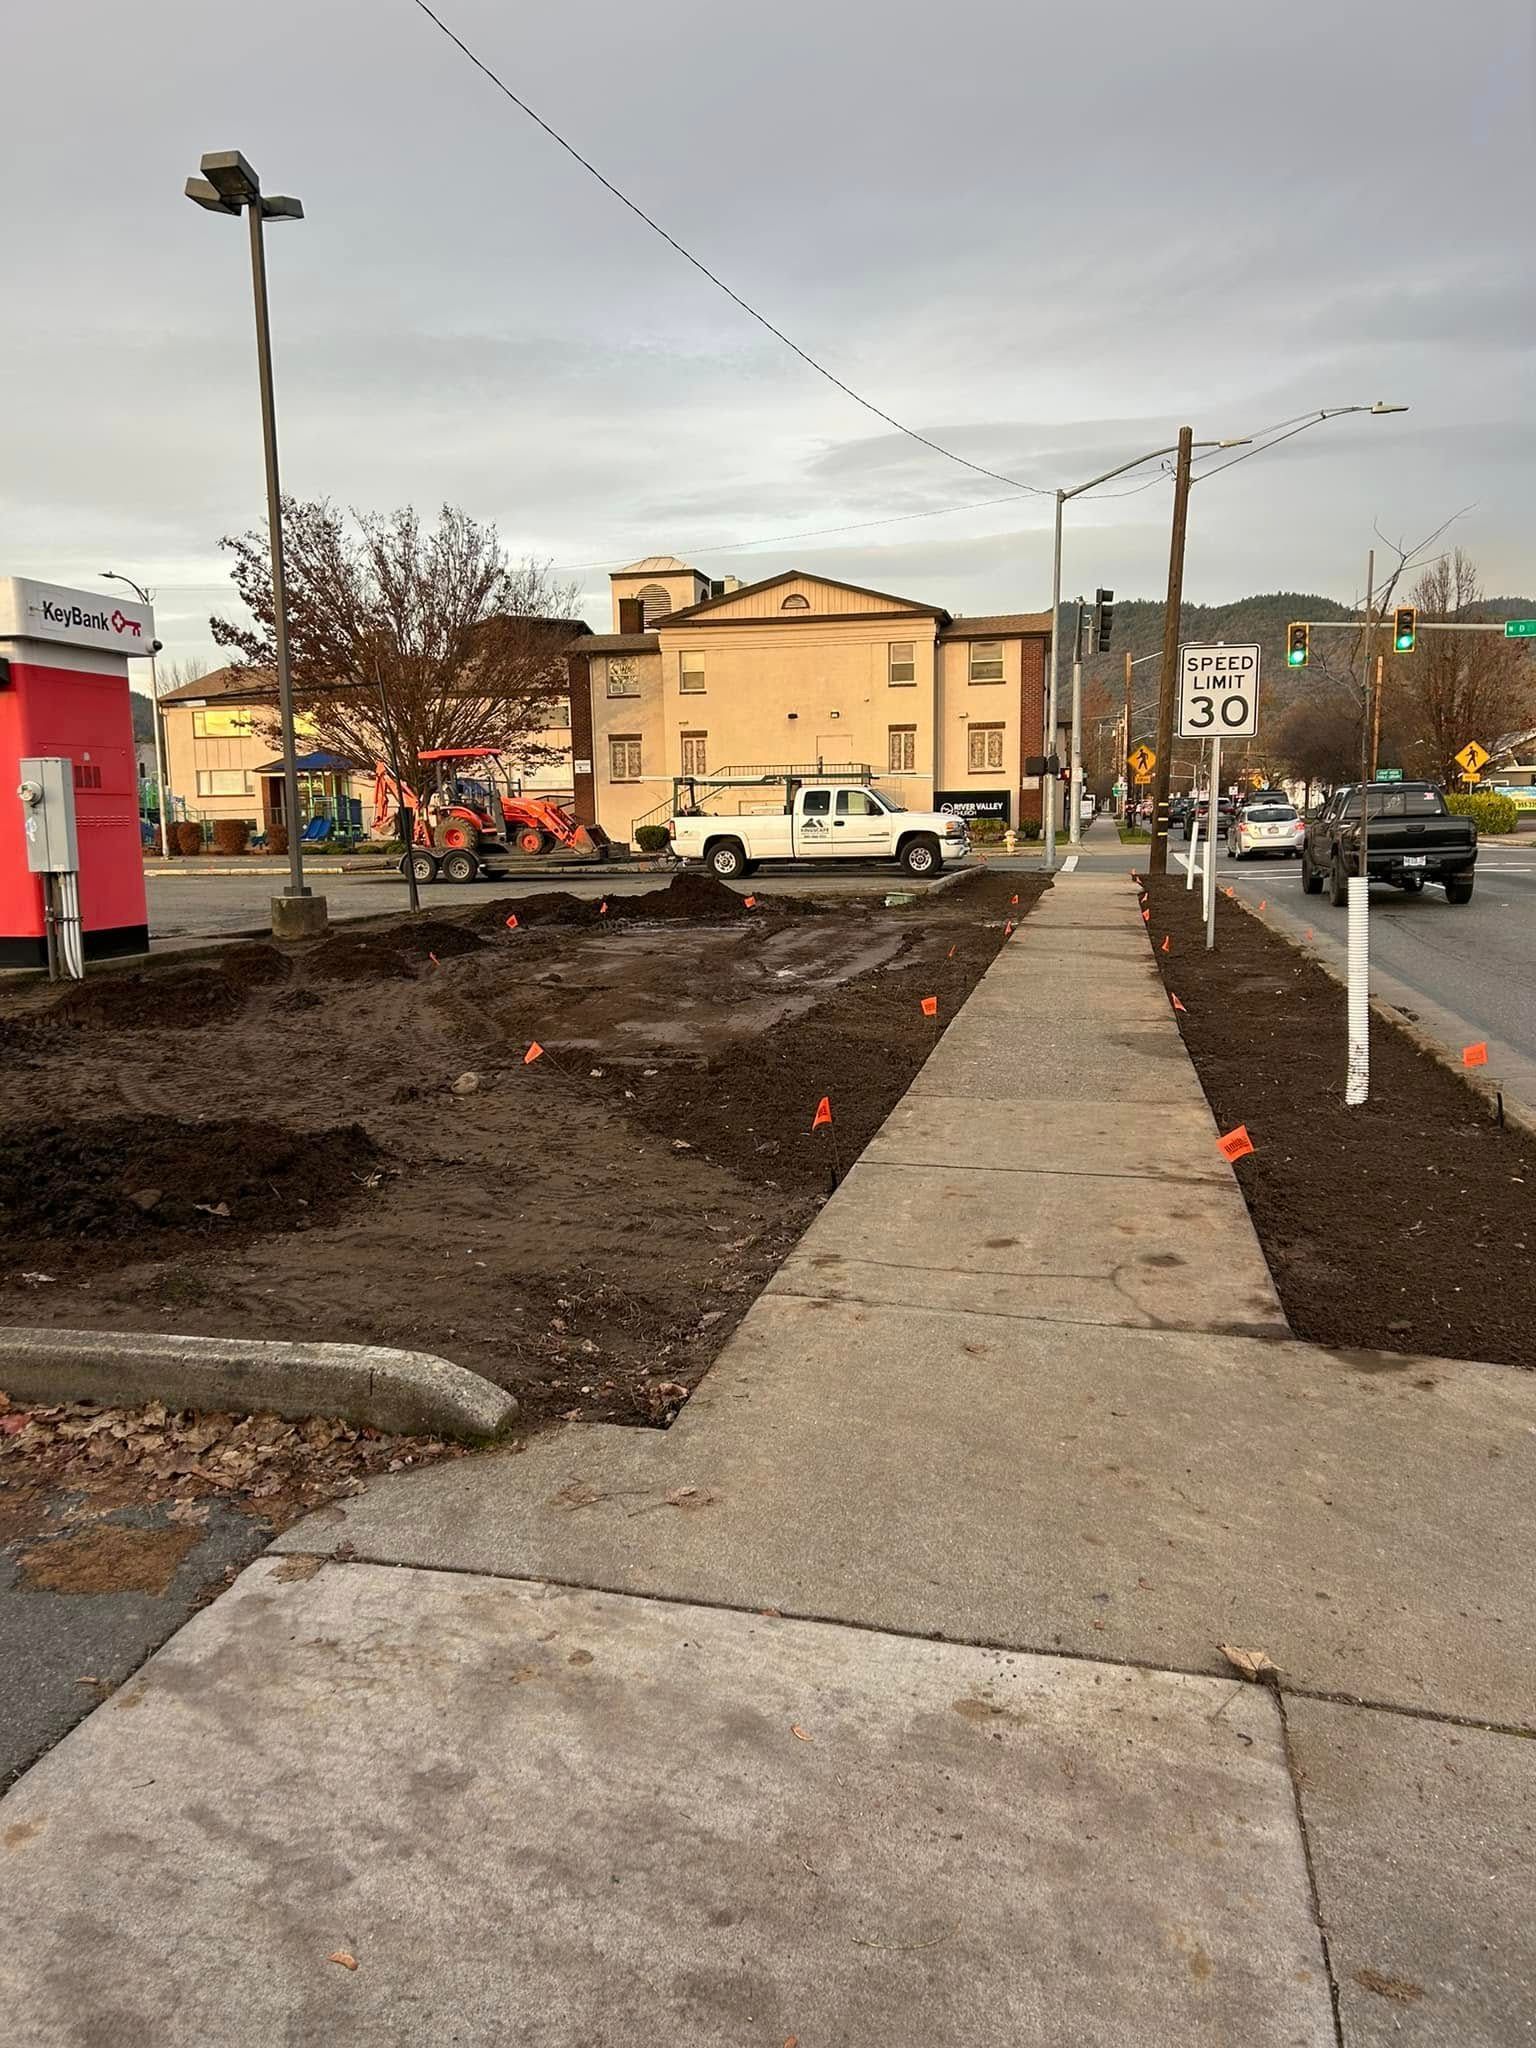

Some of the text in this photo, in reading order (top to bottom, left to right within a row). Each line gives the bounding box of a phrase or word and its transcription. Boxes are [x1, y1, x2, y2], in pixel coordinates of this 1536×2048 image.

[42, 600, 110, 631] KeyBank
[1187, 656, 1254, 672] SPEED
[1193, 674, 1246, 690] LIMIT
[1188, 695, 1249, 729] 30
[976, 802, 1003, 810] VALLEY
